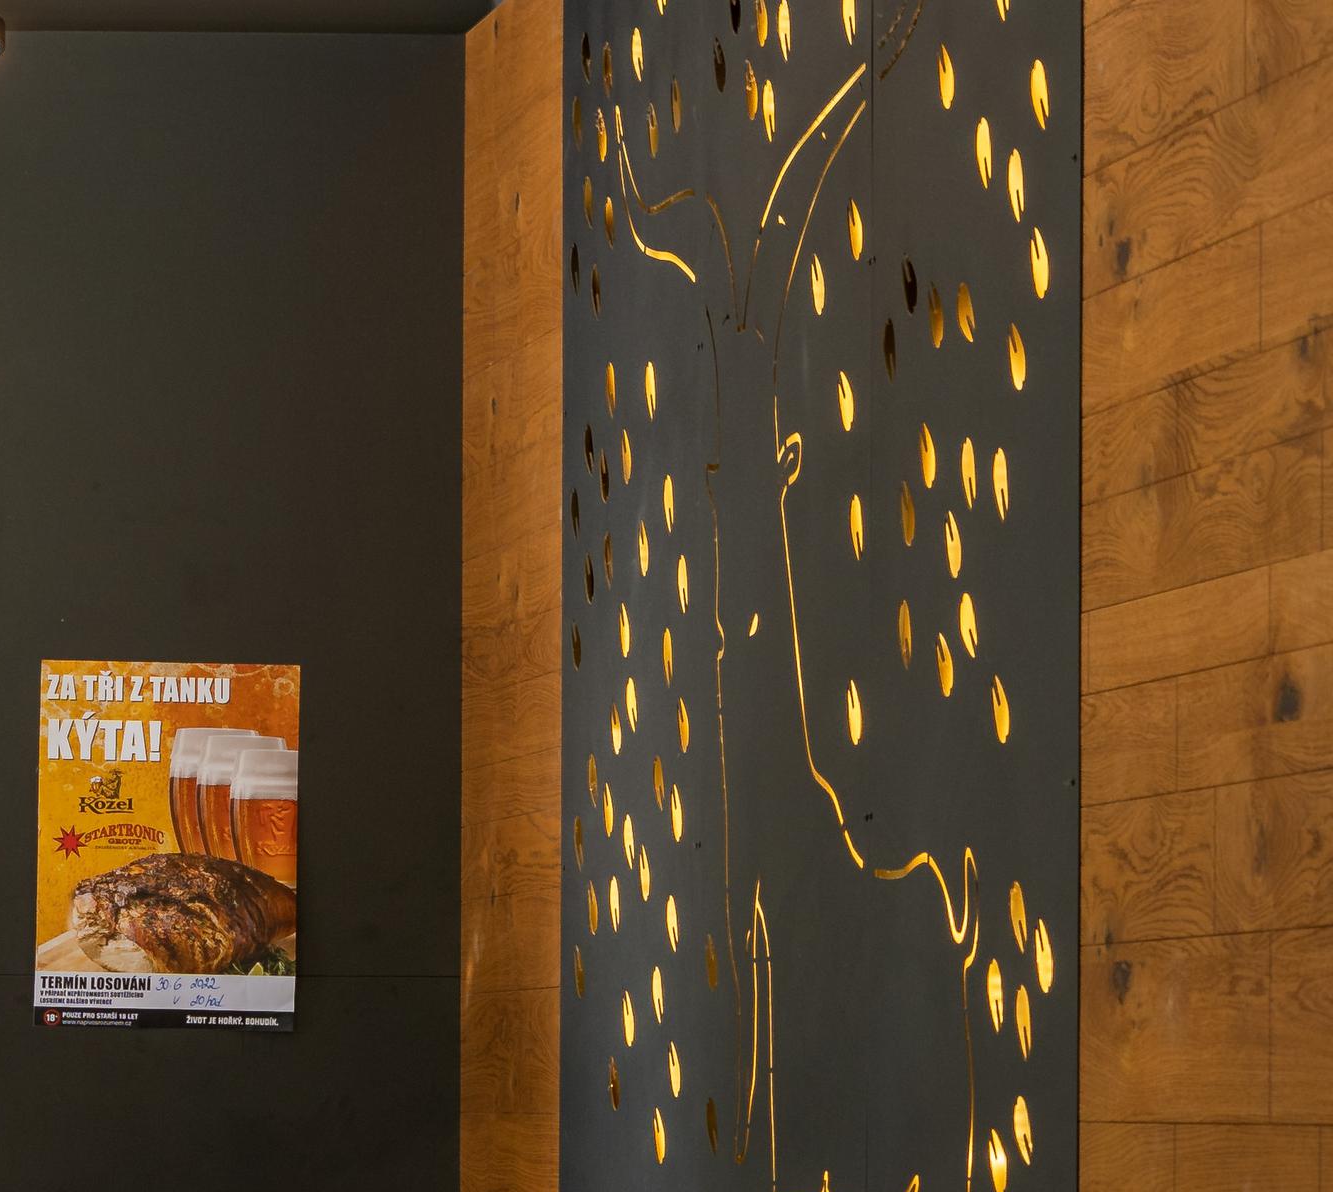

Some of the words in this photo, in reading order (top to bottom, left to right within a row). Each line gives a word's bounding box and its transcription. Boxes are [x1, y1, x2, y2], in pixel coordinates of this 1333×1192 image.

[47, 673, 77, 701] ZA
[83, 670, 124, 702] TŘI
[129, 675, 144, 702] Z
[149, 675, 232, 704] TANKU
[47, 711, 163, 762] KÝTA!
[78, 796, 134, 814] Kozel
[83, 823, 166, 845] STARTRONIC
[40, 973, 88, 990] TERMÍN
[90, 975, 151, 991] LOSOVÁNÍ
[190, 977, 221, 990] 2022
[62, 1011, 82, 1019] POUZE
[96, 1011, 118, 1020] STARŠÍ
[186, 1015, 207, 1025] ŽIVOT
[208, 1016, 217, 1025] JE
[218, 1016, 244, 1026] HOŘKÝ.
[245, 1016, 279, 1027] BOHUDÍK.
